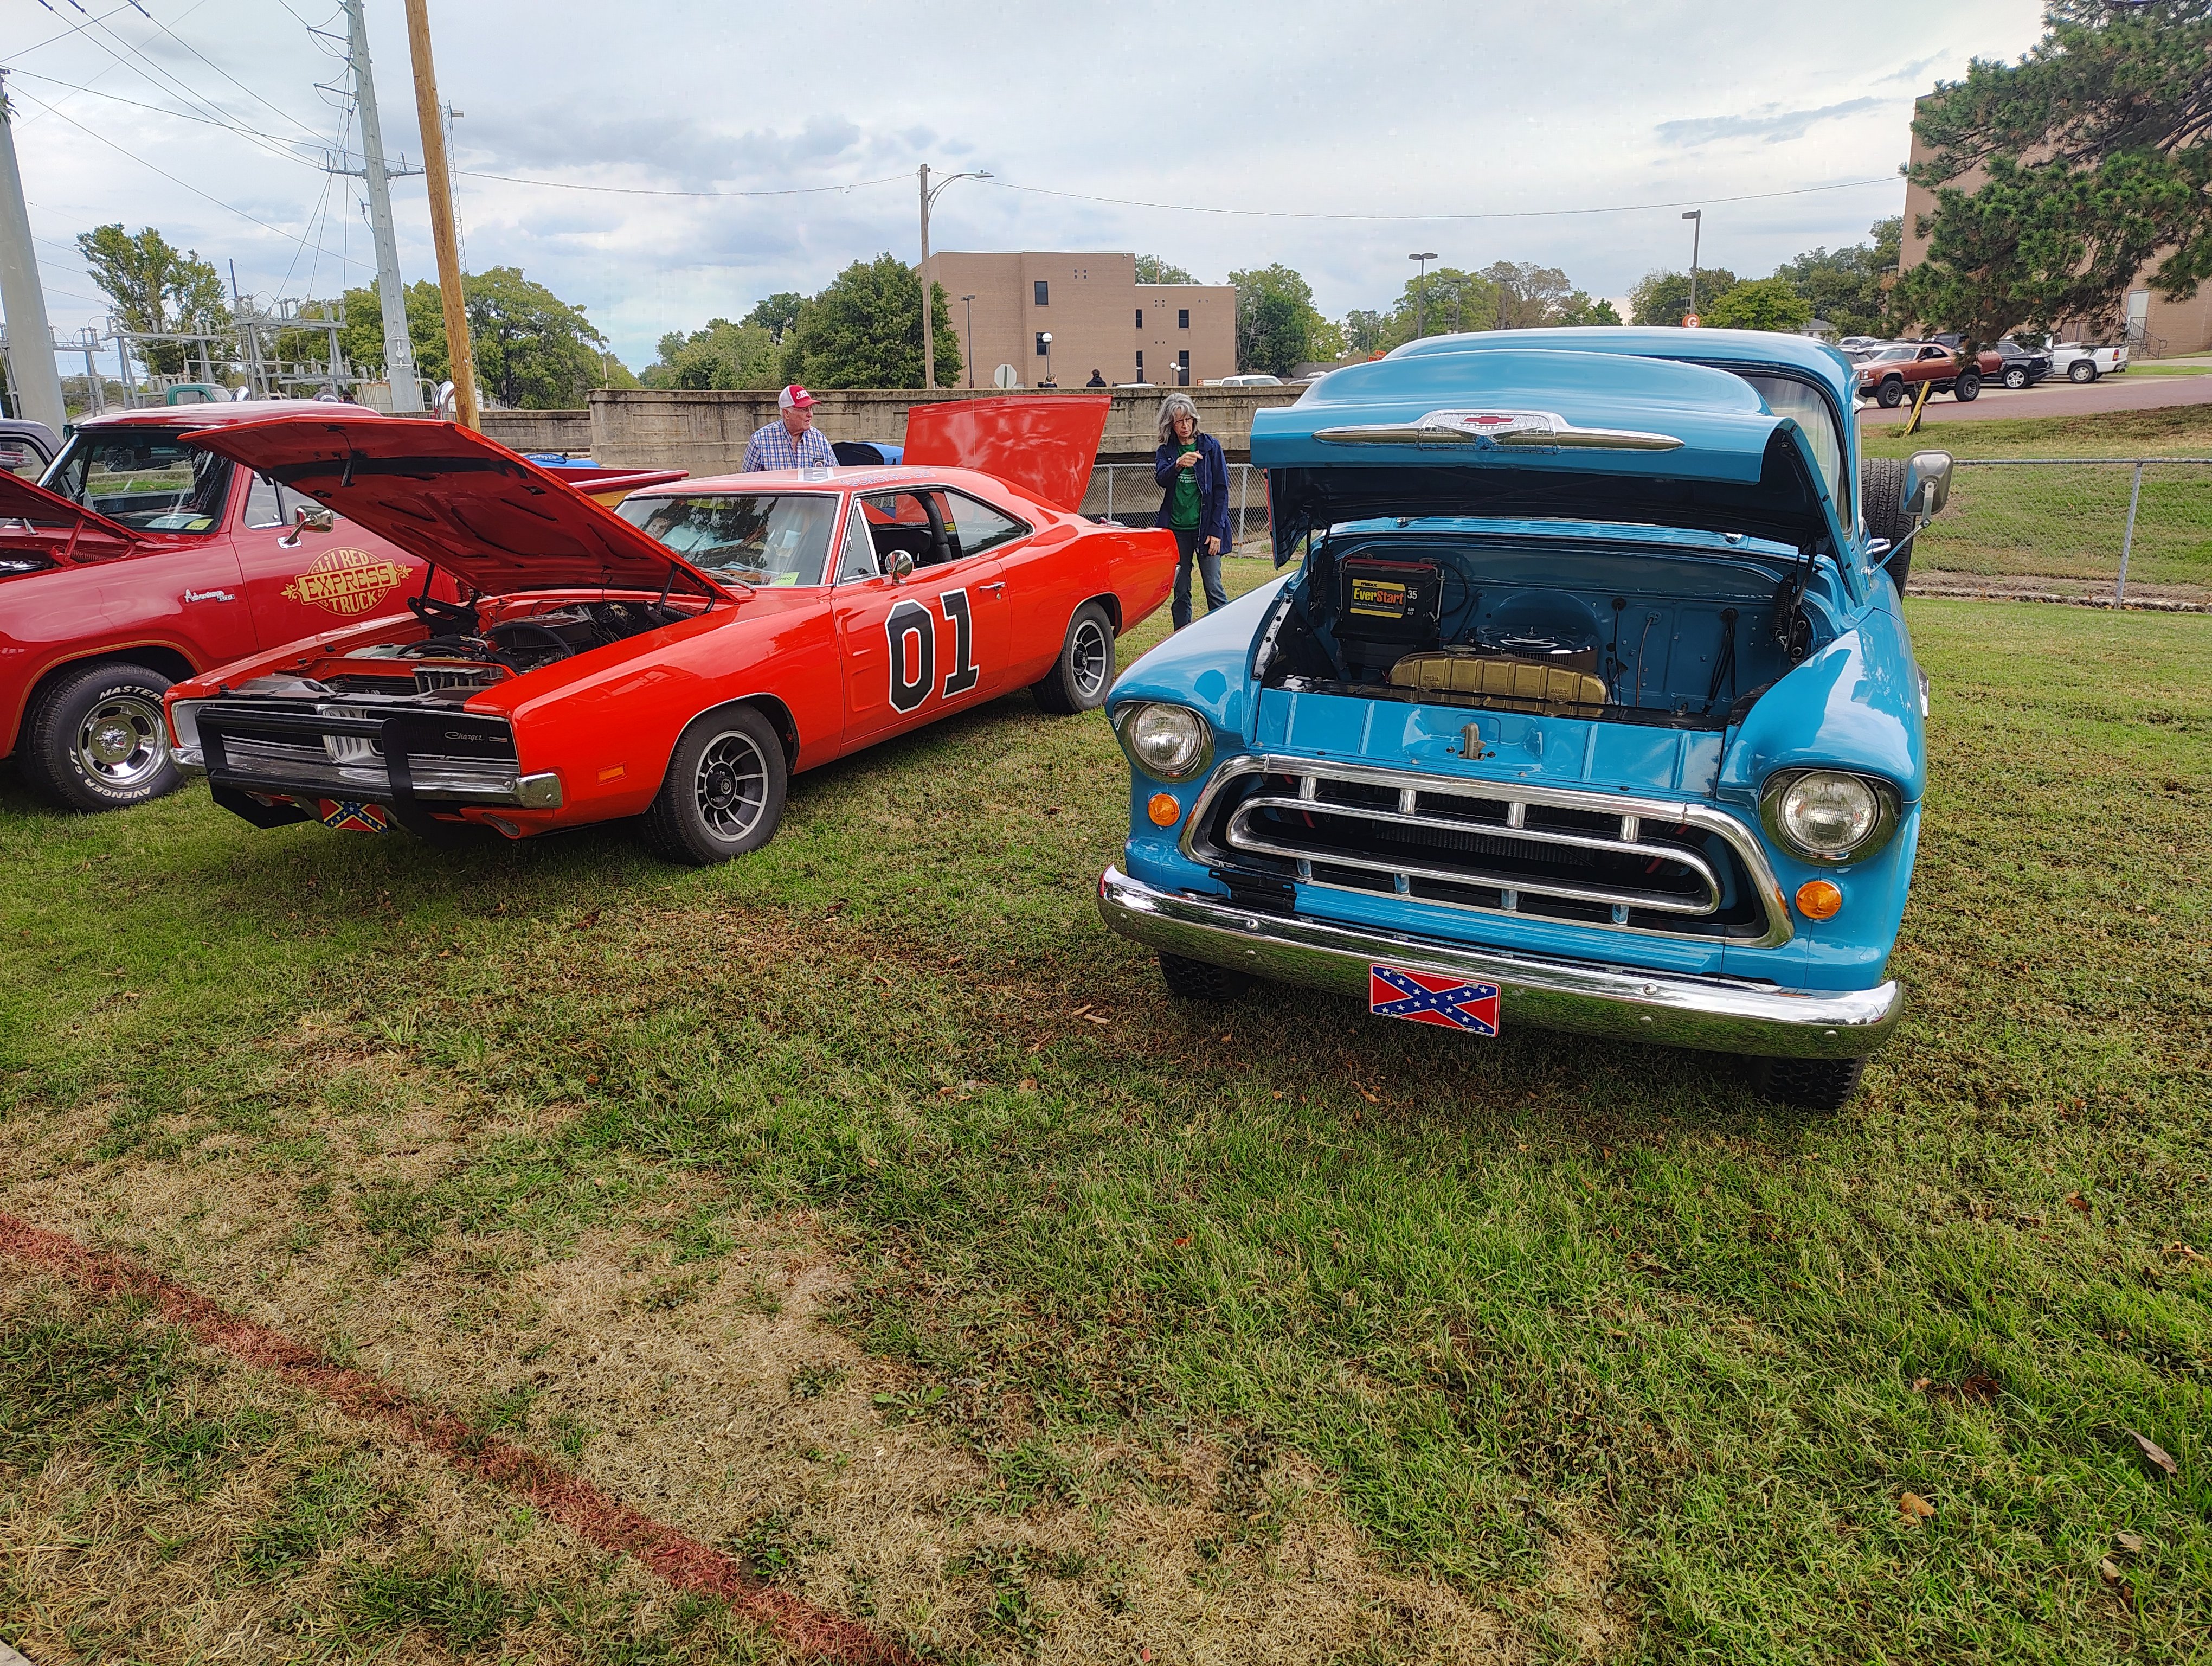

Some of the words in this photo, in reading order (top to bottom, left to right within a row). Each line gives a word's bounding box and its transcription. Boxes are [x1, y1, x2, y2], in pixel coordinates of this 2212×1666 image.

[1687, 317, 1697, 328] G
[339, 549, 369, 568] RED
[305, 565, 392, 599] EXPRESS
[328, 591, 376, 613] TRUCK
[1353, 588, 1404, 605] EverStart
[1407, 589, 1418, 600] 35
[884, 587, 980, 714] 01
[445, 731, 484, 742] Charger
[84, 778, 151, 799] AVENGER
